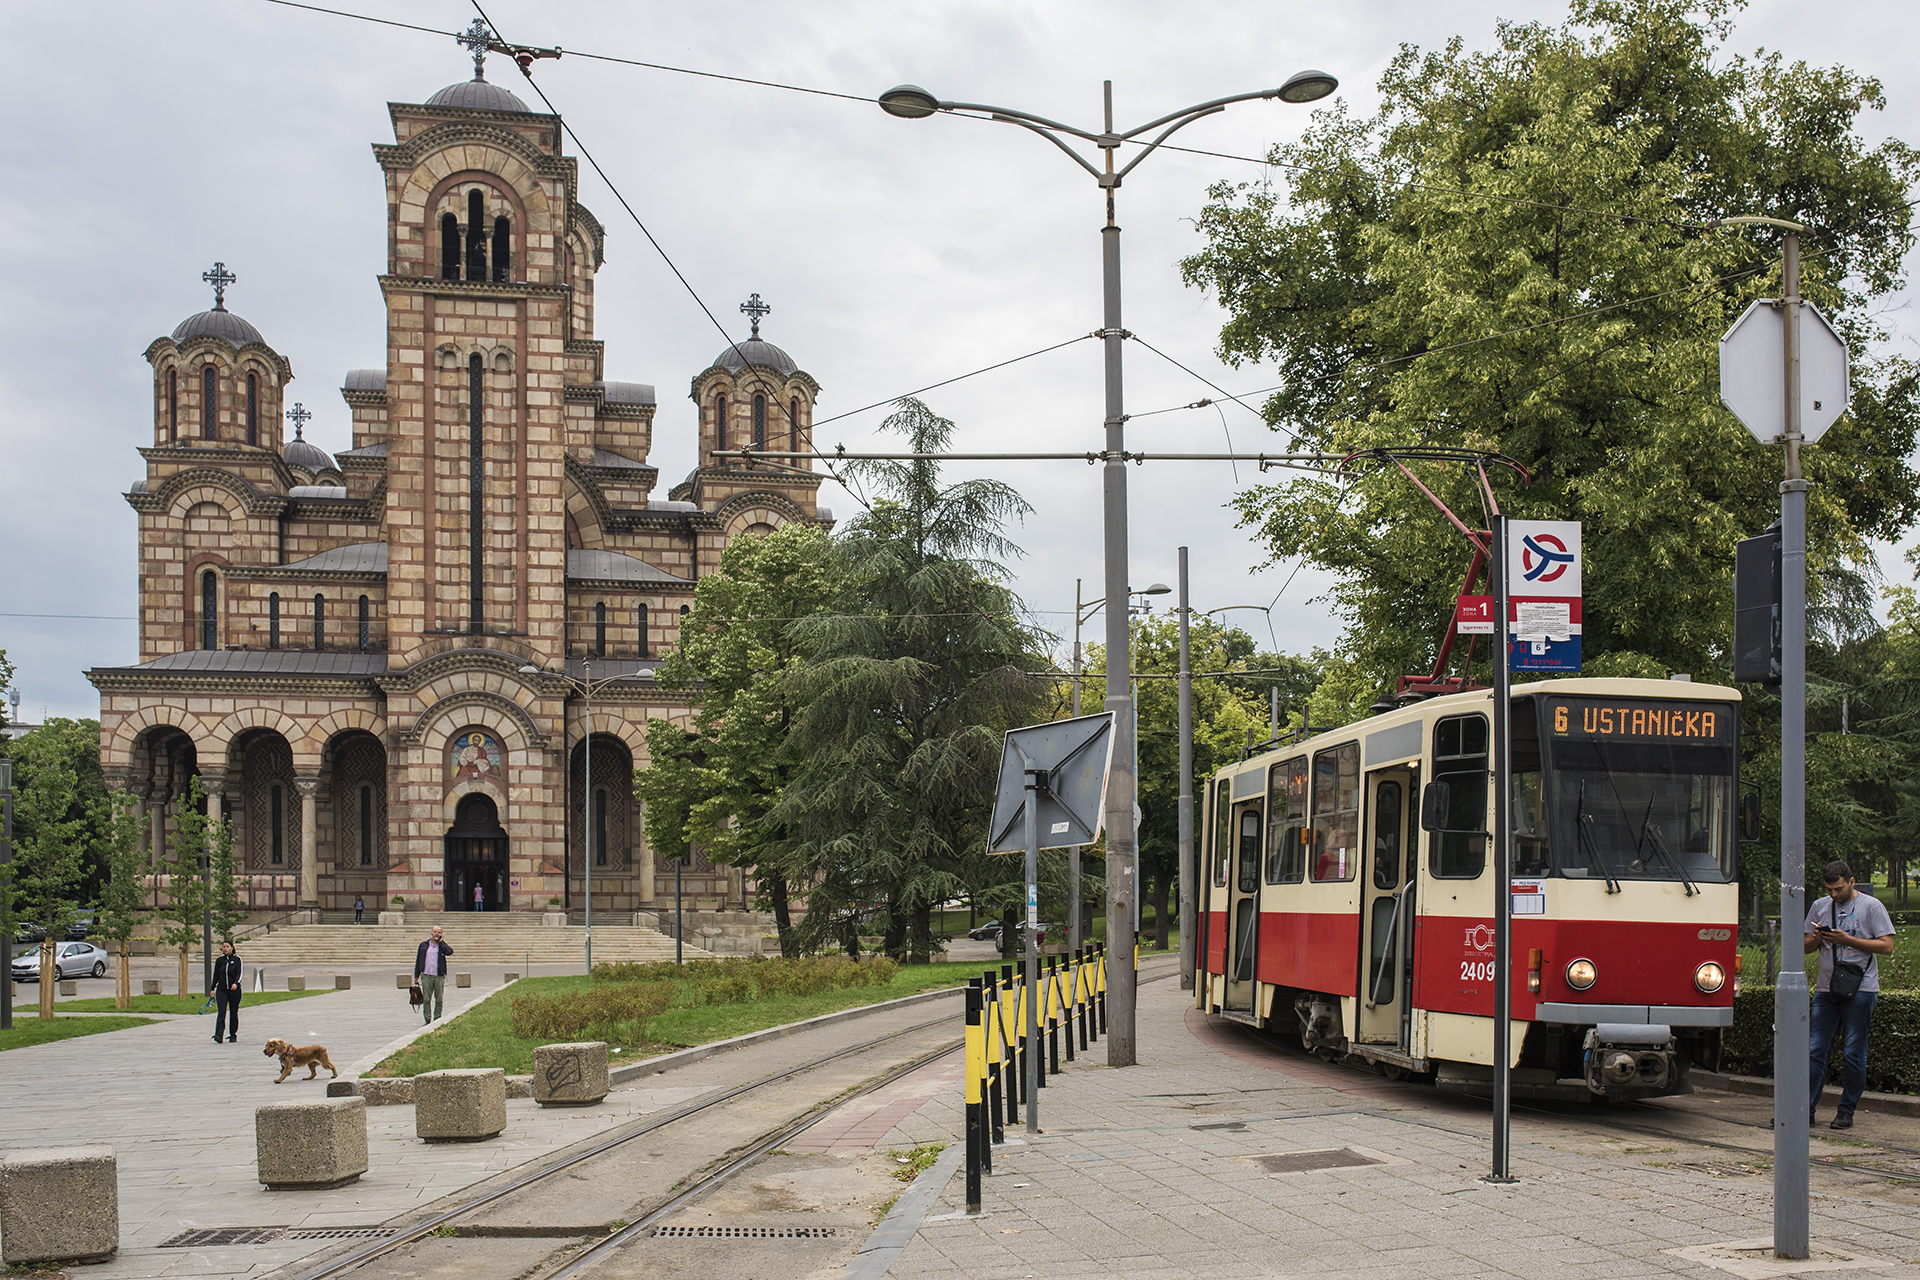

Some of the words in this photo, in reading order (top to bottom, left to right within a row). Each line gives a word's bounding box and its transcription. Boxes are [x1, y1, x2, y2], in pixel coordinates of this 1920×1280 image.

[1479, 602, 1488, 616] 1
[1554, 706, 1569, 732] 6
[1583, 707, 1716, 738] USTANIČKA
[1460, 961, 1496, 982] 2409
